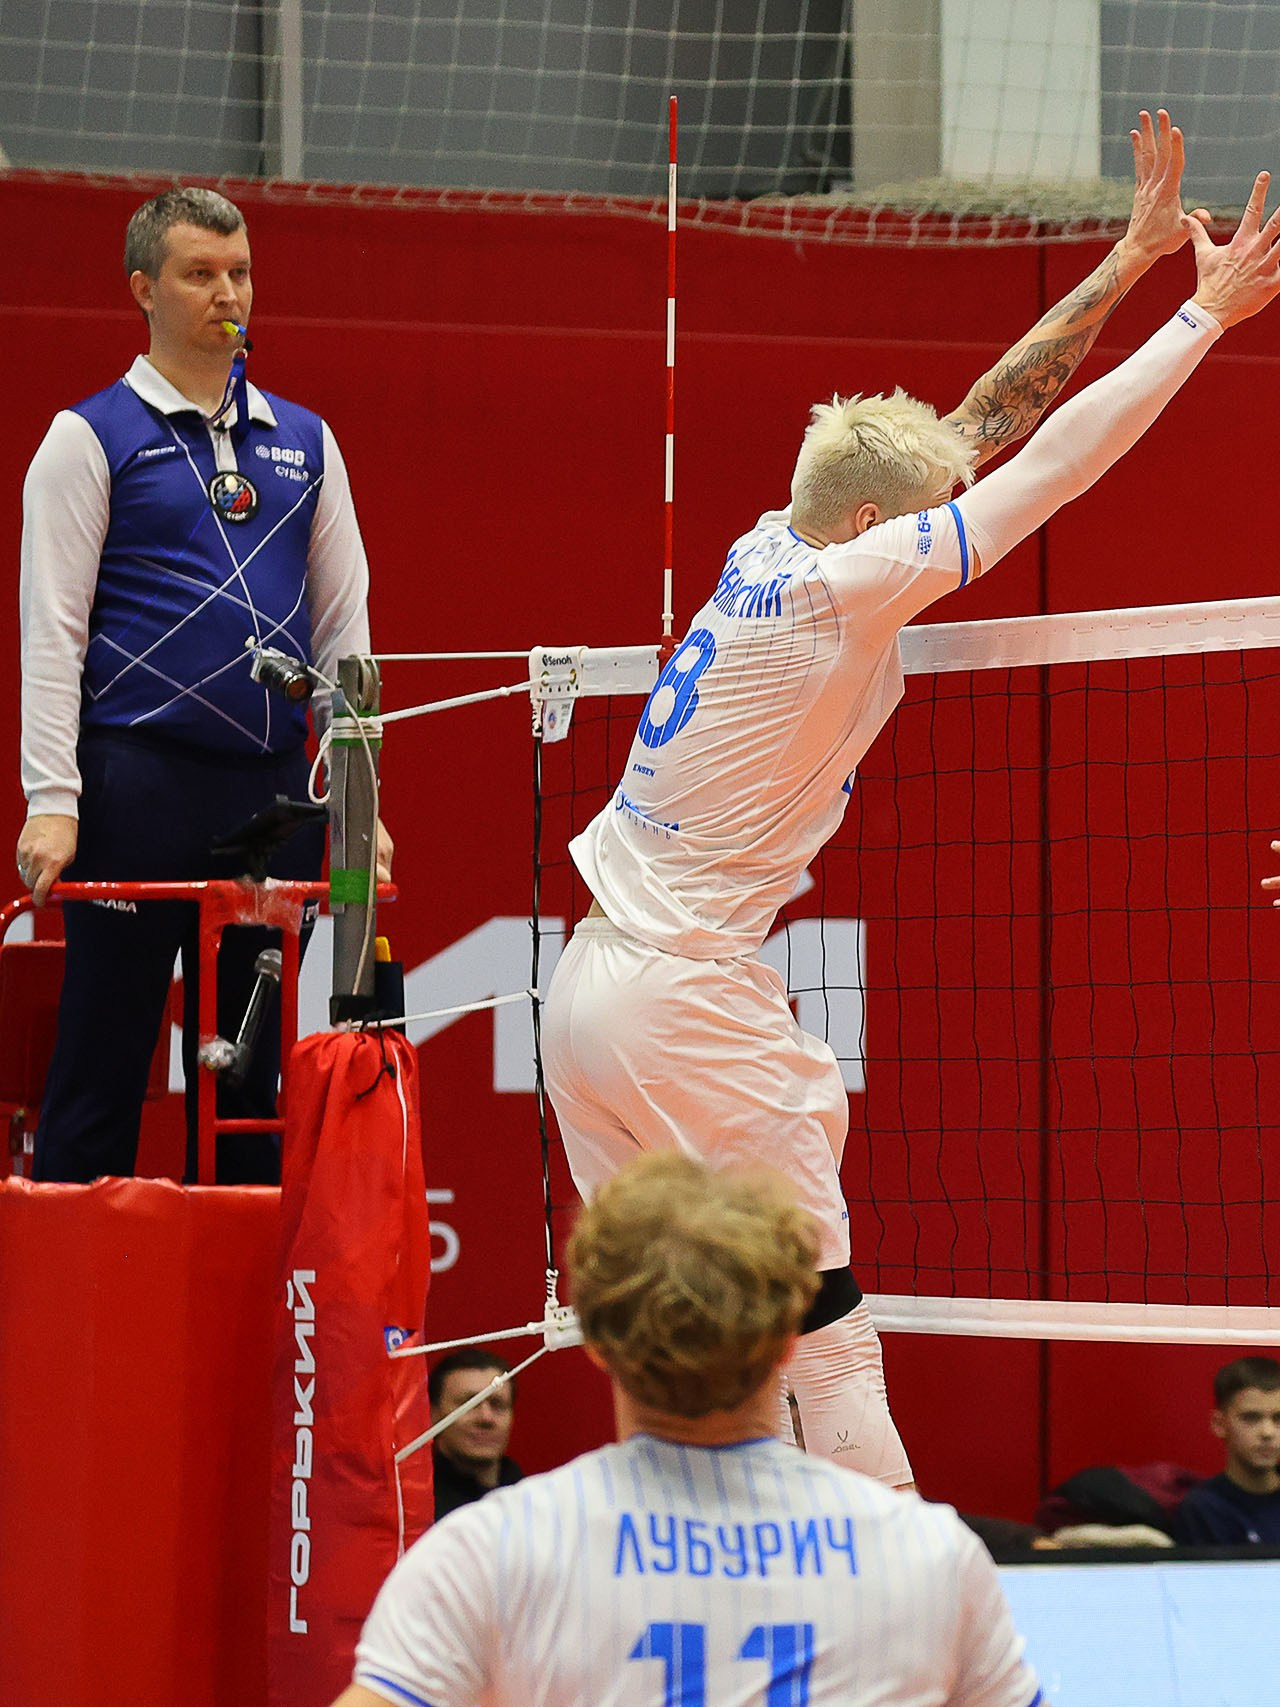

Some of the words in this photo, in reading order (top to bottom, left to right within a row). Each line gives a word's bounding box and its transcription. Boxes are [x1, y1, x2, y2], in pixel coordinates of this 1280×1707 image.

[271, 446, 305, 466] ВФВ
[548, 655, 572, 667] Senoh
[638, 628, 716, 749] 8
[632, 763, 656, 777] ENSEN
[287, 1269, 317, 1634] ГОРЬКИЙ
[614, 1512, 860, 1579] ЛУБУРИЧ
[628, 1622, 814, 1707] 11
